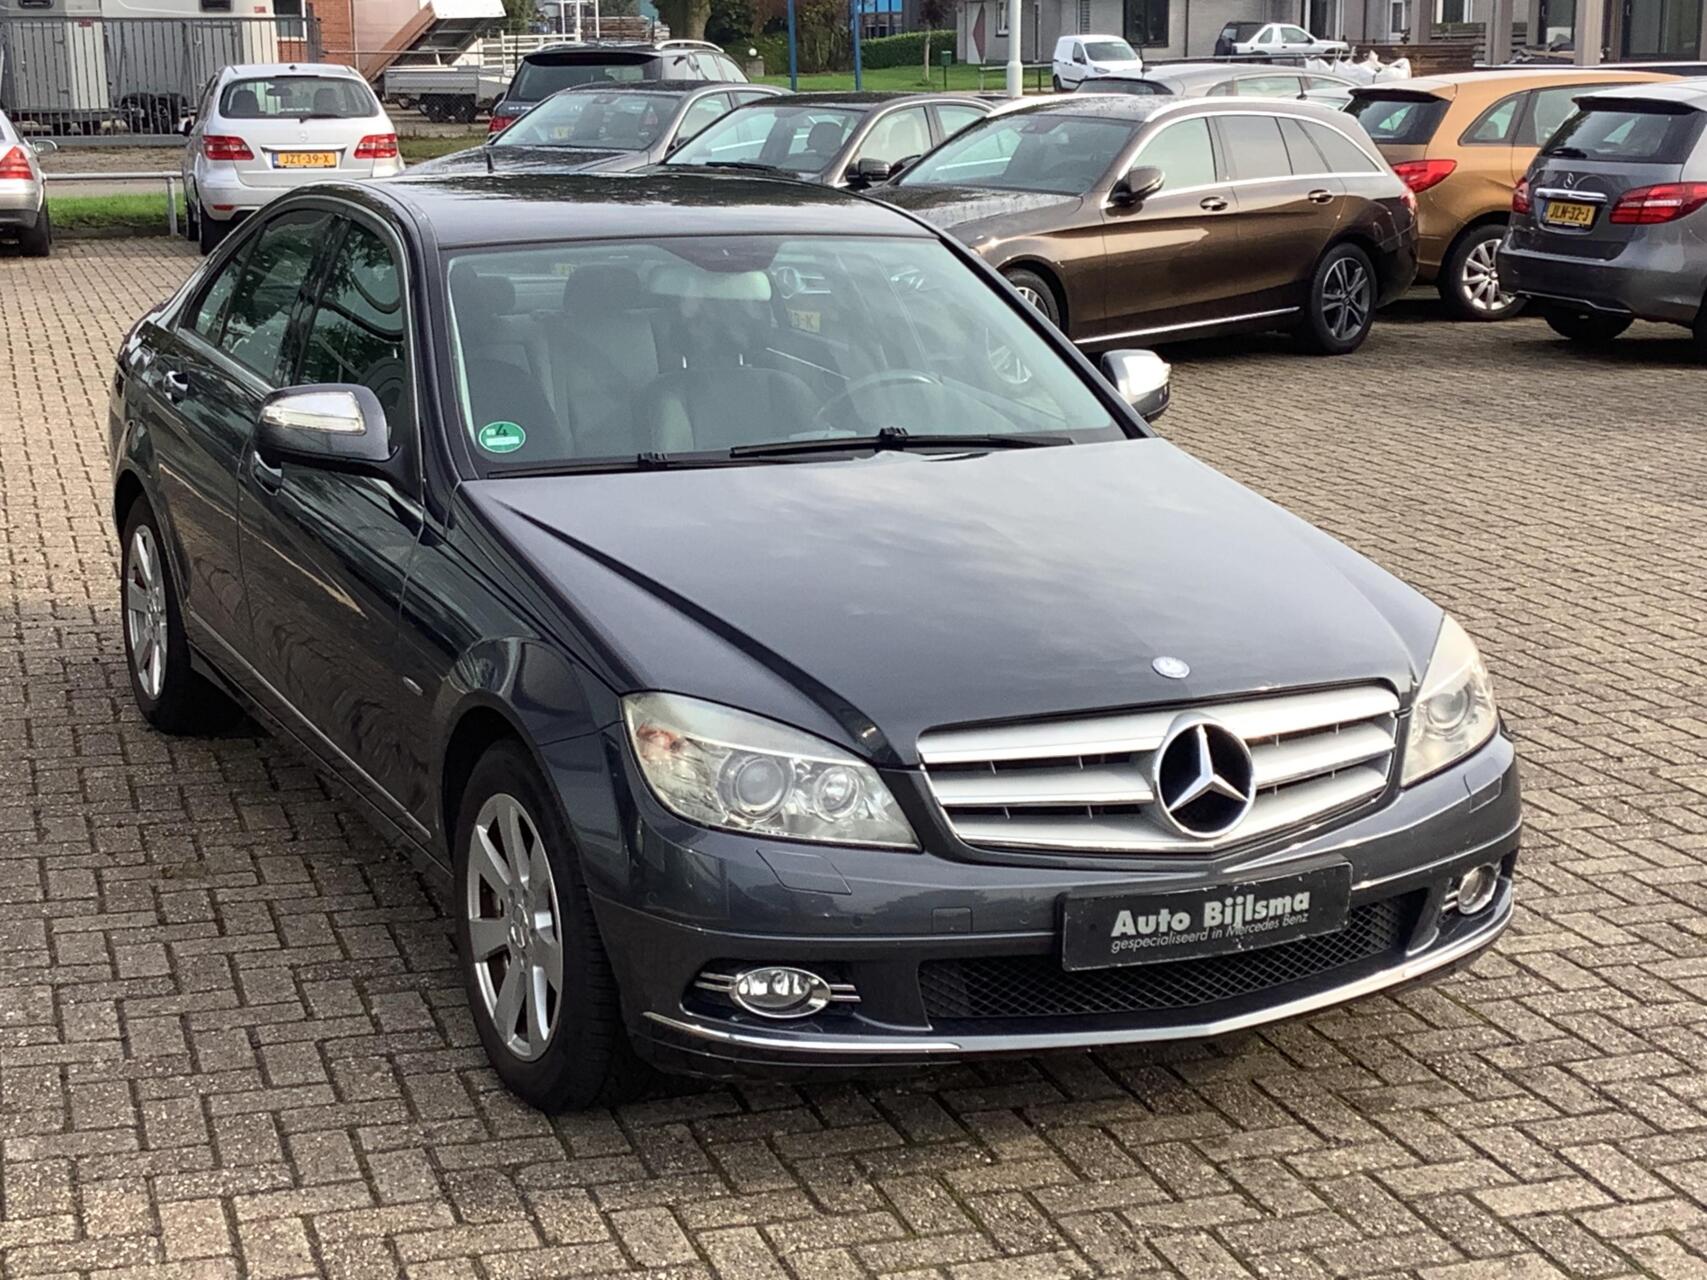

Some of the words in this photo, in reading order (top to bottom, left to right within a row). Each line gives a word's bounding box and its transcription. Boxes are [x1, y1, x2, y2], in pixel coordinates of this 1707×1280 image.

[283, 153, 330, 165] JZT-39-X
[1550, 204, 1591, 222] JLN-32-J
[496, 424, 509, 437] 4
[1110, 908, 1191, 938] Auto
[1203, 892, 1311, 930] Bijlsma
[1111, 930, 1209, 953] gespecialiseerd
[1211, 927, 1224, 938] in
[1226, 918, 1280, 937] Mercedes
[1282, 912, 1309, 927] Benz
